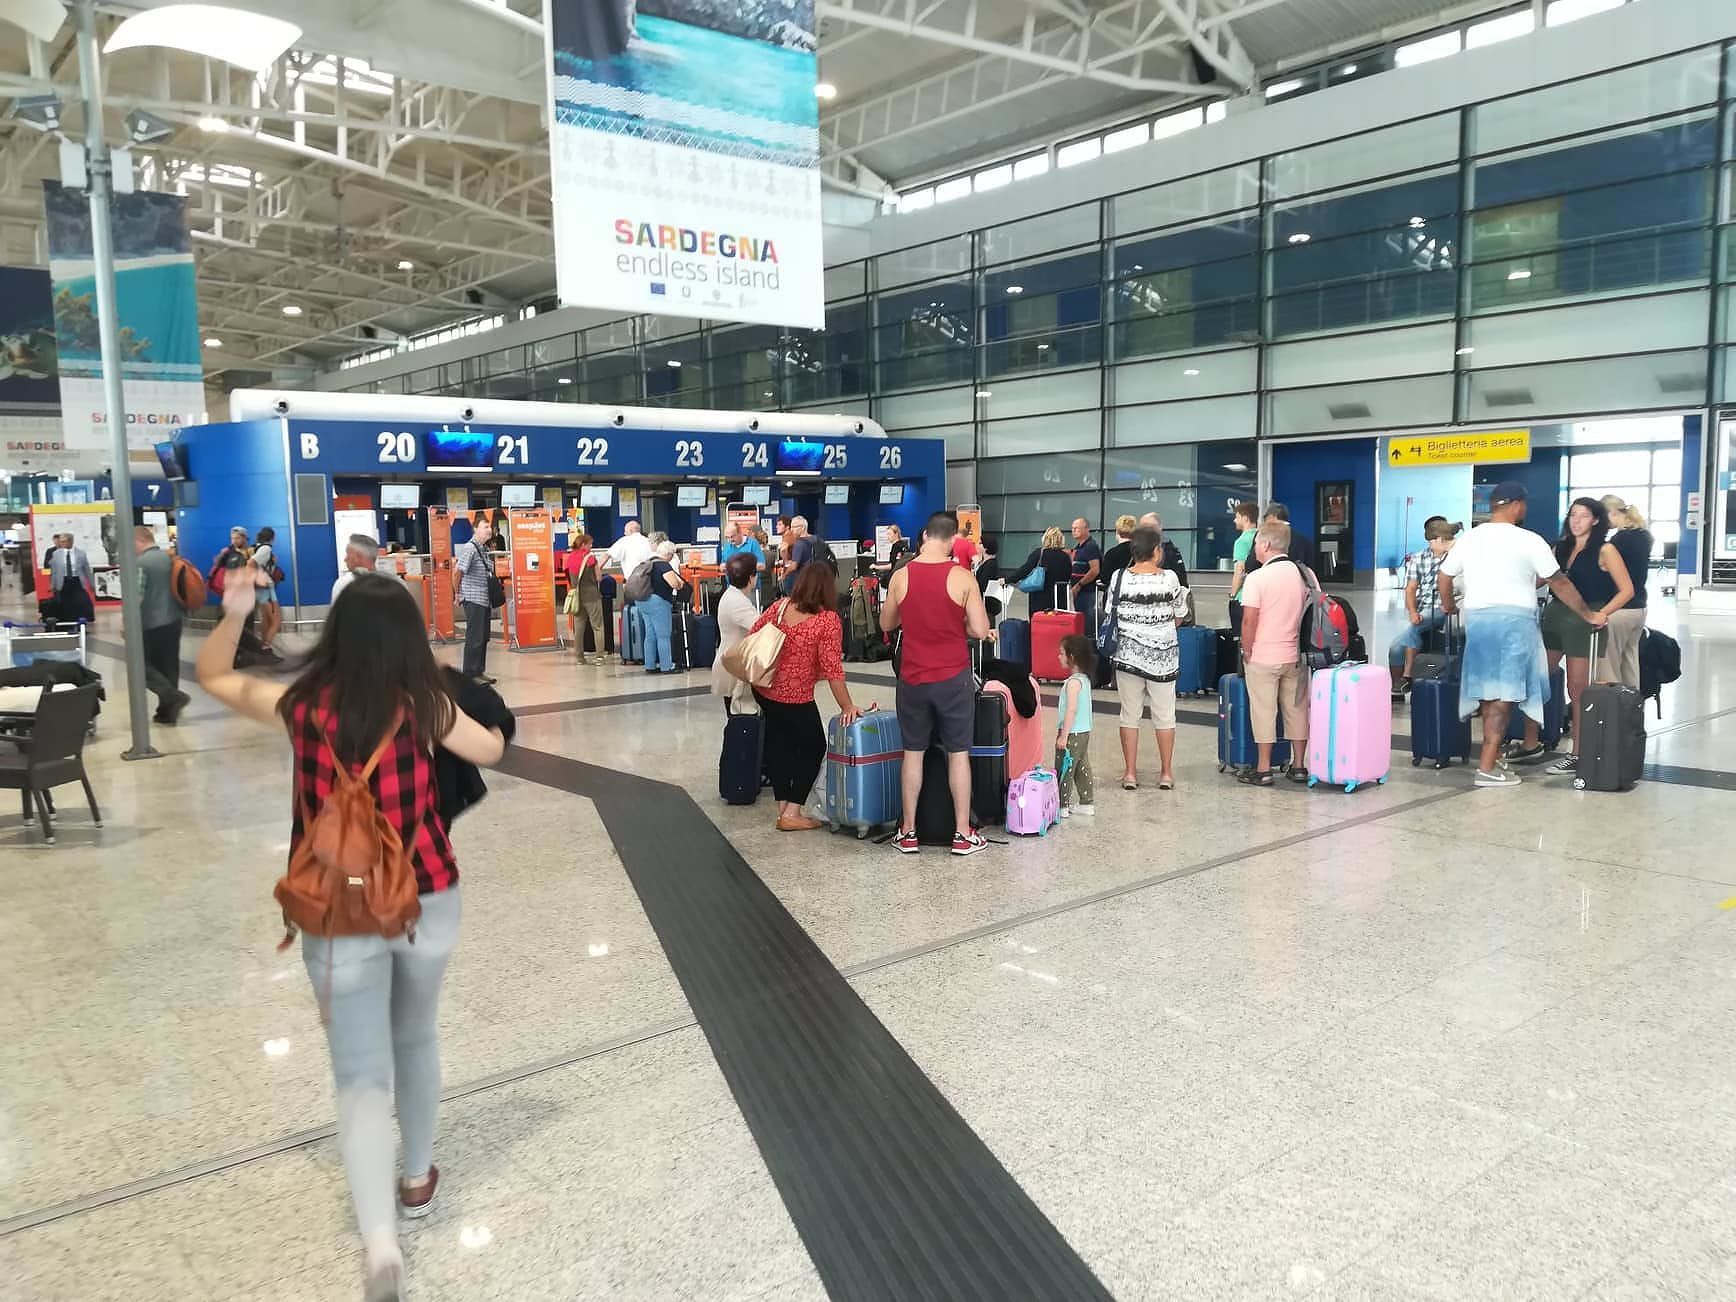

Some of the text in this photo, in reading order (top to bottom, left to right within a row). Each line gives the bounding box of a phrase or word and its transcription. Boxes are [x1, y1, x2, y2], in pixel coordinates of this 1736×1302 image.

[615, 219, 779, 264] SARDEGNA
[616, 252, 780, 290] endless island
[91, 412, 182, 425] SDEGNA
[300, 433, 320, 459] B
[376, 432, 416, 463] 20
[497, 435, 529, 465] 21
[576, 438, 609, 466] 22
[675, 441, 704, 468] 23
[742, 443, 769, 469] 24
[823, 445, 848, 469] 25
[879, 446, 902, 470] 26
[147, 484, 160, 499] 7
